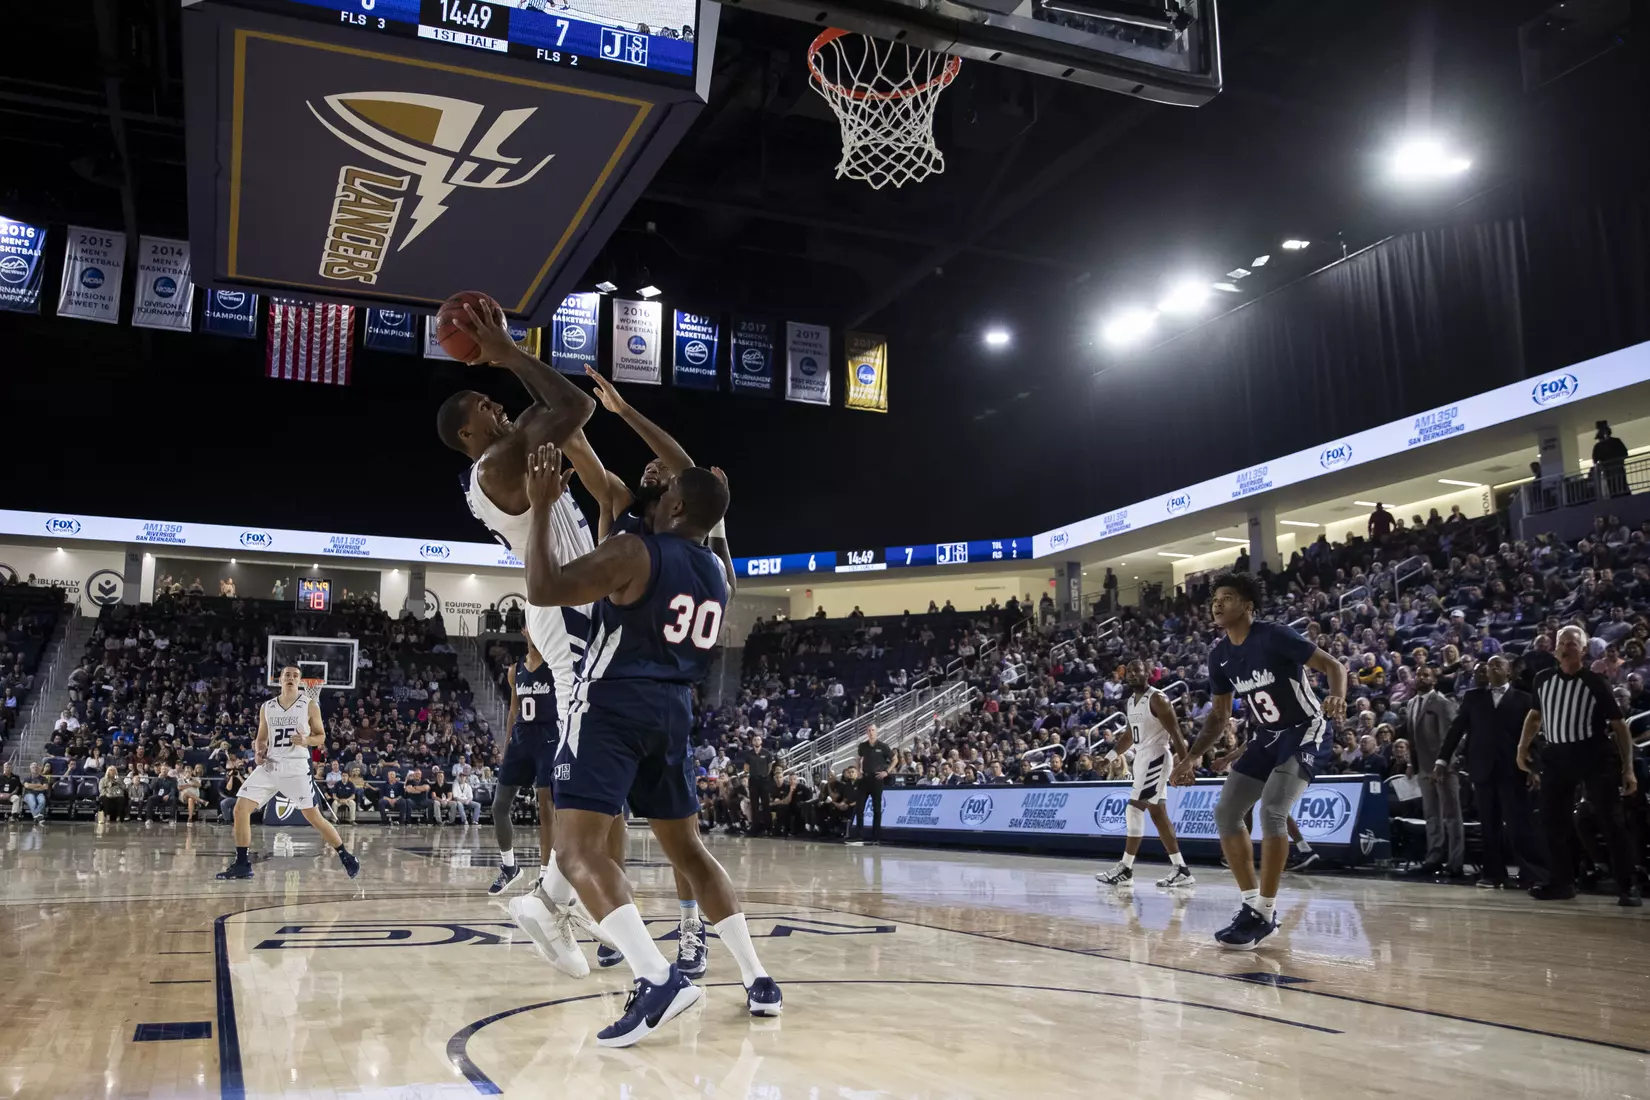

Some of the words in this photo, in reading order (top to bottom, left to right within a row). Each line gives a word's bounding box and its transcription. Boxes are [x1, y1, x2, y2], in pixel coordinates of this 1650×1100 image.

[341, 11, 367, 25] FLS
[378, 18, 386, 29] 3
[440, 0, 492, 29] 14:49
[433, 29, 458, 42] 1ST
[465, 34, 498, 48] HALF
[556, 19, 570, 46] 7
[536, 48, 560, 62] FLS
[570, 55, 578, 66] 2
[319, 165, 412, 285] LANCERS
[0, 225, 35, 238] 2016
[1, 236, 30, 246] MEN'S
[80, 235, 113, 248] 2015
[0, 246, 41, 256] SKETBALL
[81, 248, 108, 257] MEN'S
[152, 245, 183, 257] 2014
[68, 254, 120, 267] BASKETBALL
[152, 258, 179, 266] MEN'S
[140, 264, 191, 276] BASKETBALL
[66, 290, 106, 300] DIVISION
[69, 300, 98, 308] SWEET
[144, 300, 178, 310] DIVISION
[204, 310, 254, 322] CHAMPIONS
[556, 308, 591, 318] WOMEN'S
[624, 306, 650, 318] 2016
[620, 318, 652, 326] WOMEN'S
[684, 313, 710, 324] 2017
[368, 326, 414, 338] CHAMPIONS
[616, 324, 658, 334] BASKETBALL
[679, 323, 712, 333] WOMEN'S
[740, 322, 766, 332] 2017
[676, 330, 718, 342] BASKETBALL
[796, 330, 820, 340] 2017
[552, 351, 596, 362] CHAMPIONS
[620, 356, 648, 365] DIVISION
[616, 364, 659, 372] TOURNAMENT
[676, 366, 717, 376] CHAMPIONS
[1541, 376, 1569, 396] FOX
[1542, 390, 1570, 402] SPORTS
[1414, 406, 1458, 430] AM1350
[1418, 420, 1452, 436] RIVERSIDE
[1408, 437, 1420, 446] SAN
[1422, 424, 1464, 442] BERNARDINO
[1326, 447, 1345, 461] FOX
[1236, 466, 1268, 483] AM1350
[1239, 478, 1264, 490] RIVERSIDE
[1242, 480, 1273, 496] BERNARDINO
[1171, 496, 1186, 508] FOX
[53, 520, 74, 530] FOX
[142, 522, 182, 533] AM1350
[246, 533, 265, 543] FOX
[330, 536, 366, 546] AM1350
[1012, 540, 1017, 548] 4
[1054, 535, 1065, 543] FOX
[426, 546, 444, 554] FOX
[808, 554, 816, 571] 6
[847, 550, 874, 565] 14:49
[905, 548, 913, 565] 7
[748, 557, 782, 575] CBU
[38, 578, 80, 586] IBLICALLY
[663, 593, 722, 650] 30
[522, 697, 535, 721] 0
[1248, 690, 1280, 724] 13
[274, 728, 294, 747] 25
[907, 794, 942, 806] AM1350
[966, 799, 988, 813] FOX
[1021, 793, 1069, 808] AM1350
[1179, 792, 1220, 809] AM13
[906, 808, 933, 816] RIVERSIDE
[1103, 798, 1129, 816] FOX
[1298, 798, 1338, 819] FOX
[1022, 809, 1058, 819] RIVERSIDE
[1182, 810, 1214, 821] RIVERS
[896, 816, 906, 824] SAN
[906, 816, 939, 825] BERNARDINO
[1009, 818, 1021, 828] SAN
[1022, 819, 1067, 829] BERNARDINO
[1296, 819, 1335, 829] SPORTS
